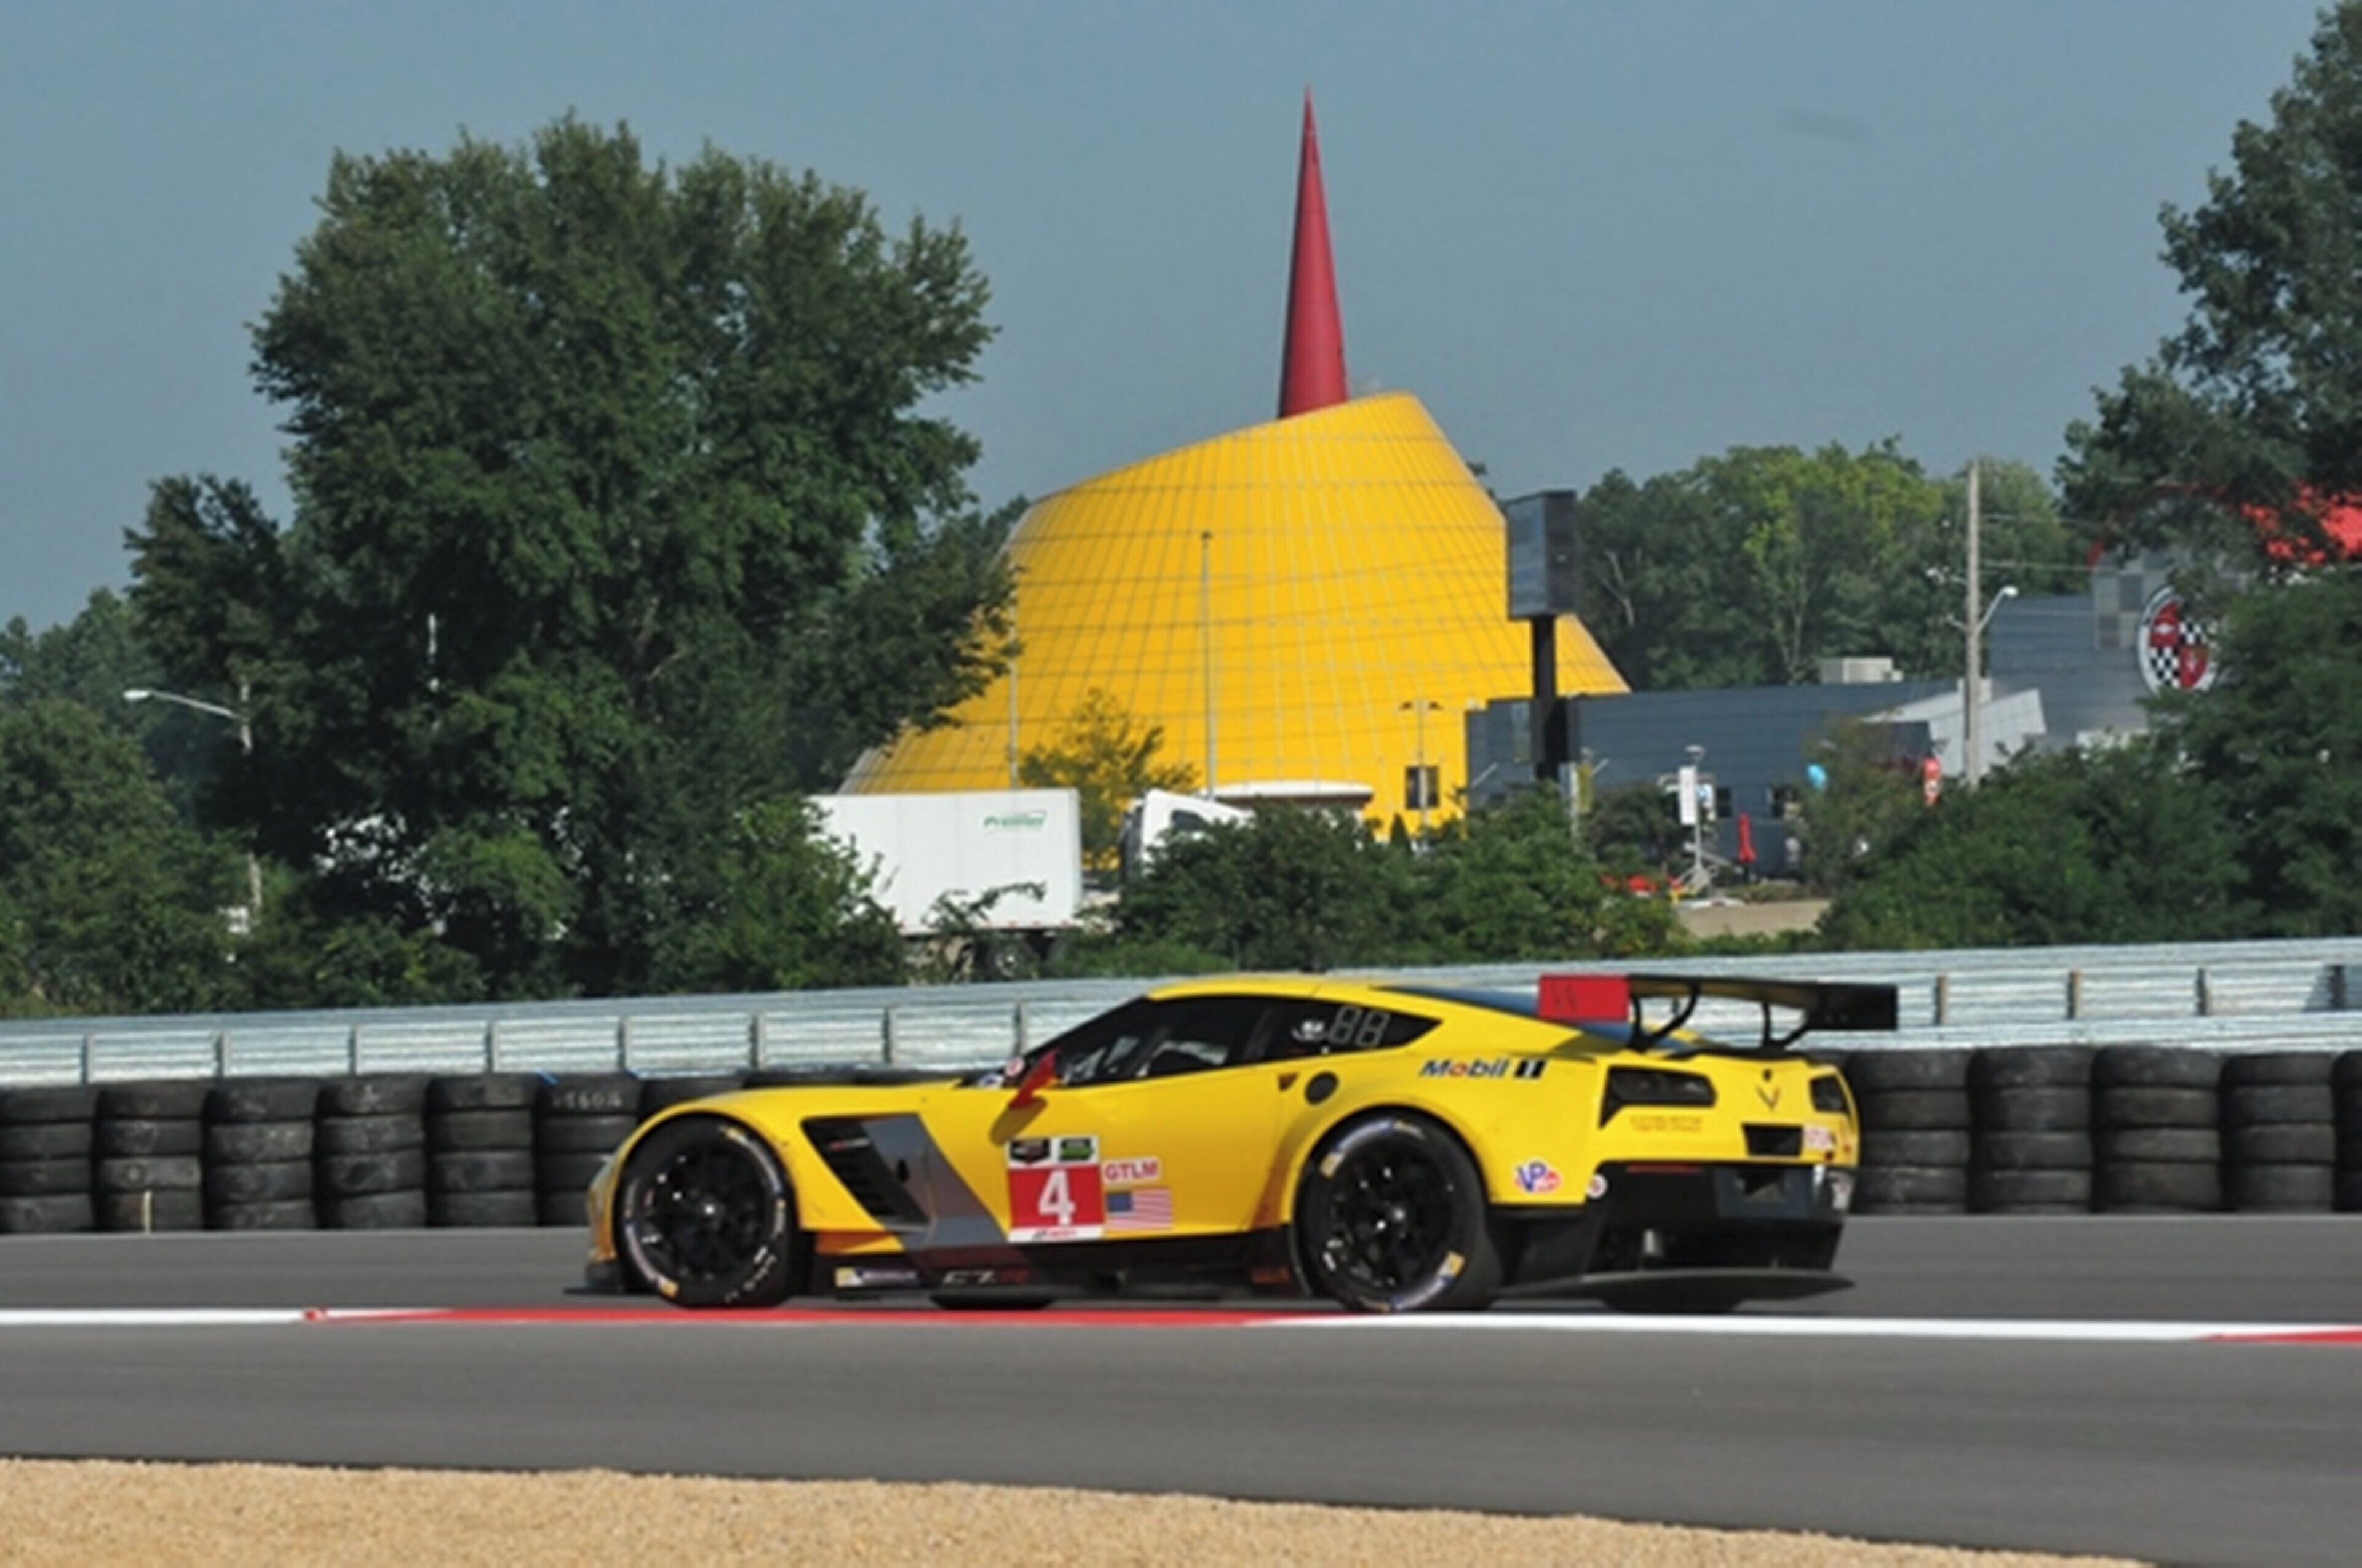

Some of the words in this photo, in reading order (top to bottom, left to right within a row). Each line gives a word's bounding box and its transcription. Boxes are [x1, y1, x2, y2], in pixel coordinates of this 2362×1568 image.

[1418, 1058, 1509, 1077] Mobil
[1105, 1161, 1158, 1180] GTLM
[1038, 1168, 1076, 1225] 4
